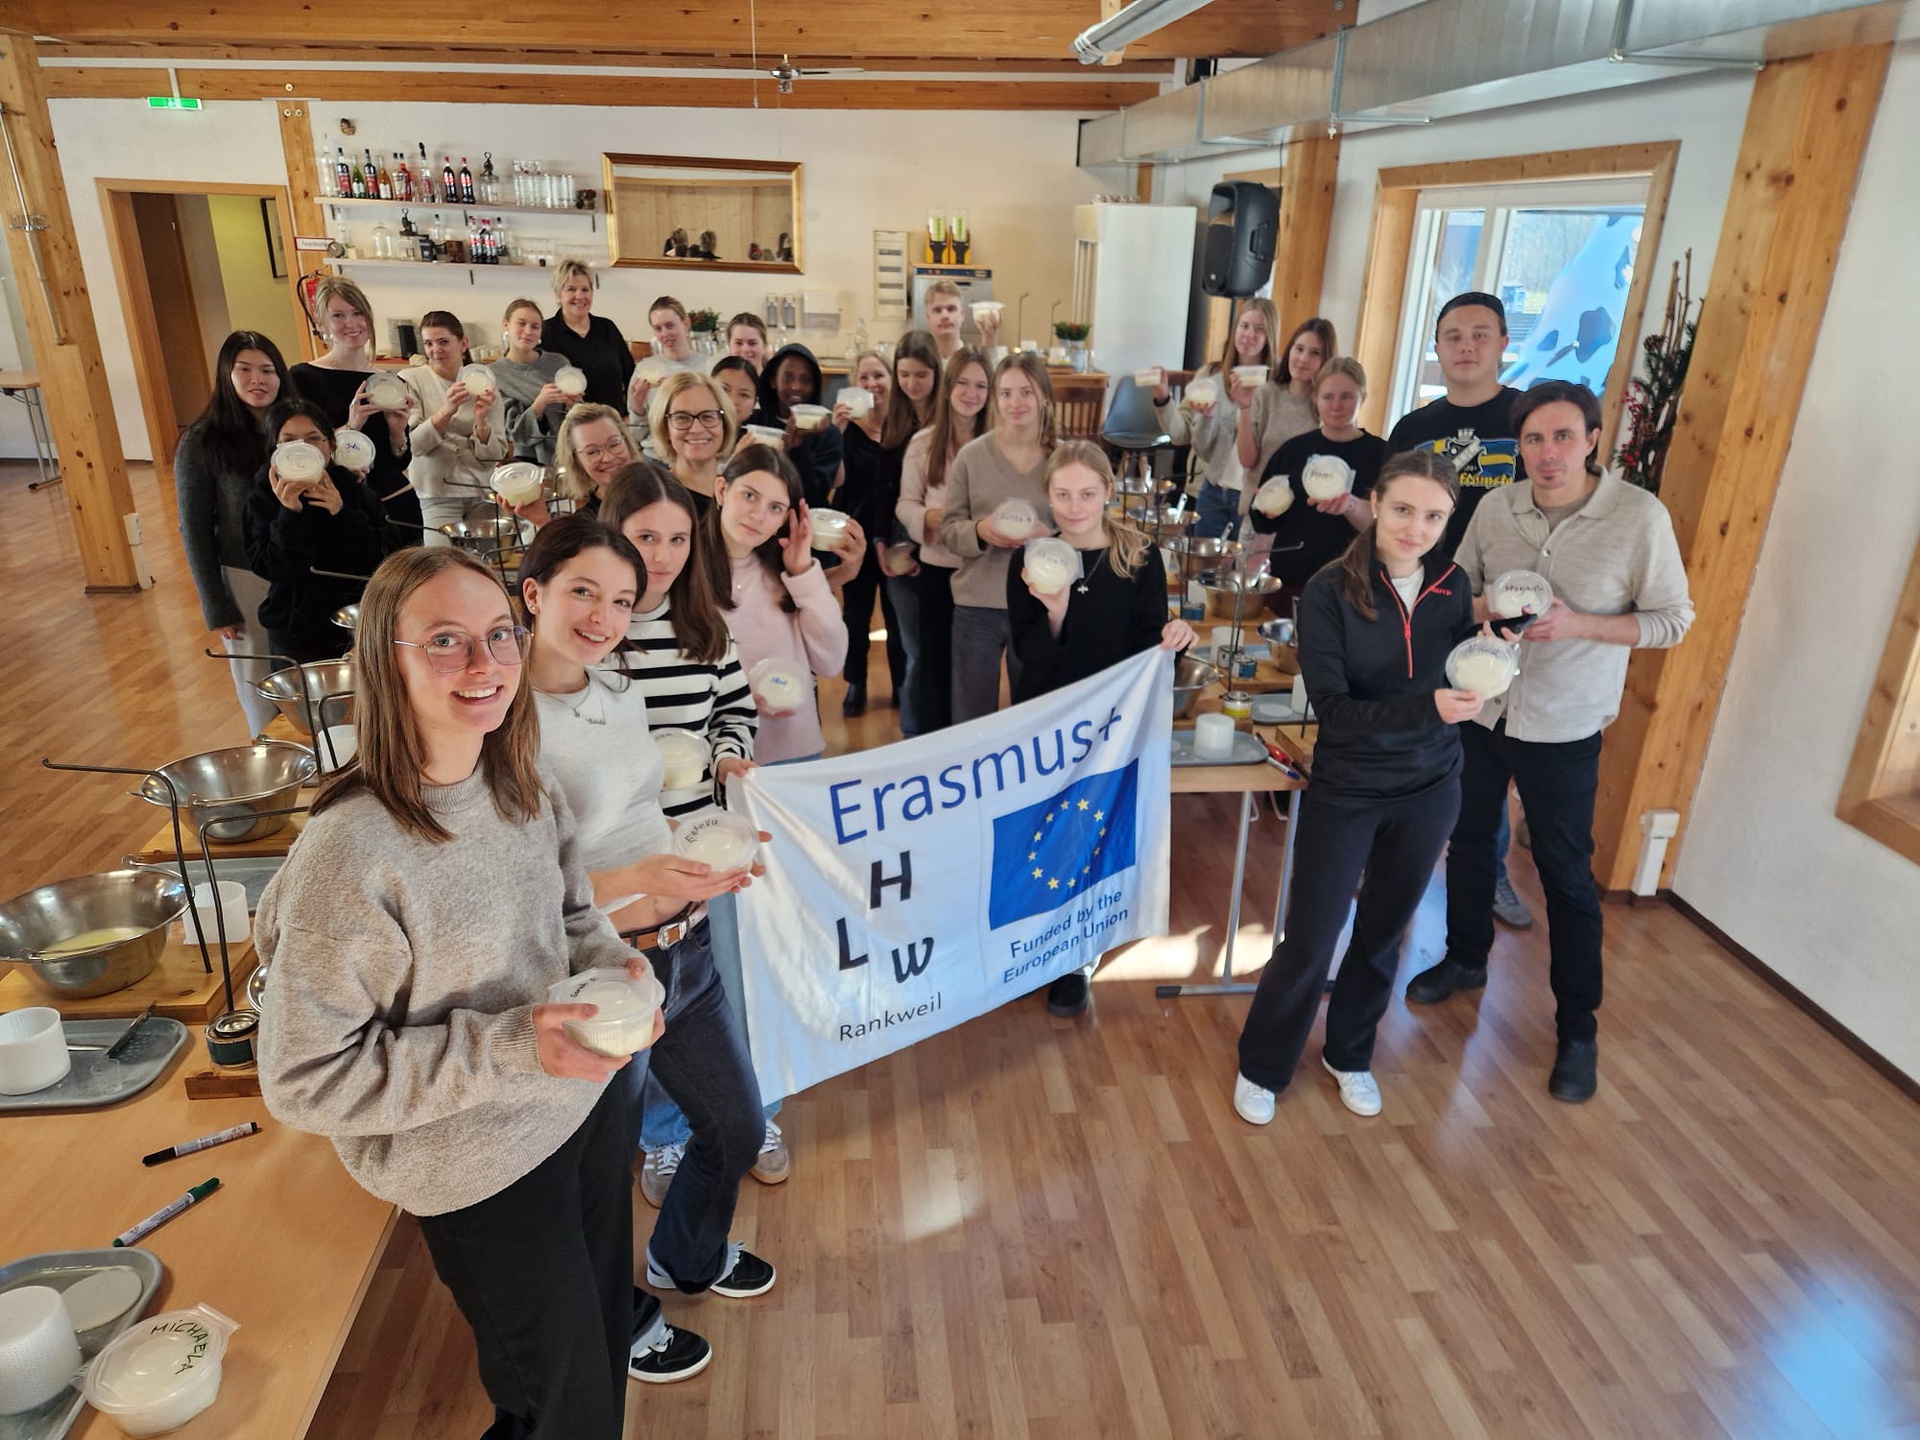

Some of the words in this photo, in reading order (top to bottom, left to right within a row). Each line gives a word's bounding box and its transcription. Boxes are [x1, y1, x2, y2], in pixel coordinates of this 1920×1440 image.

[829, 707, 1122, 845] Erasmus+
[870, 850, 912, 909] H
[836, 917, 869, 971] L
[1003, 935, 1080, 984] European
[1083, 908, 1128, 939] Union
[1010, 914, 1072, 959] Funded
[1077, 904, 1094, 923] by
[1098, 891, 1122, 910] the
[839, 991, 941, 1041] Rankweil
